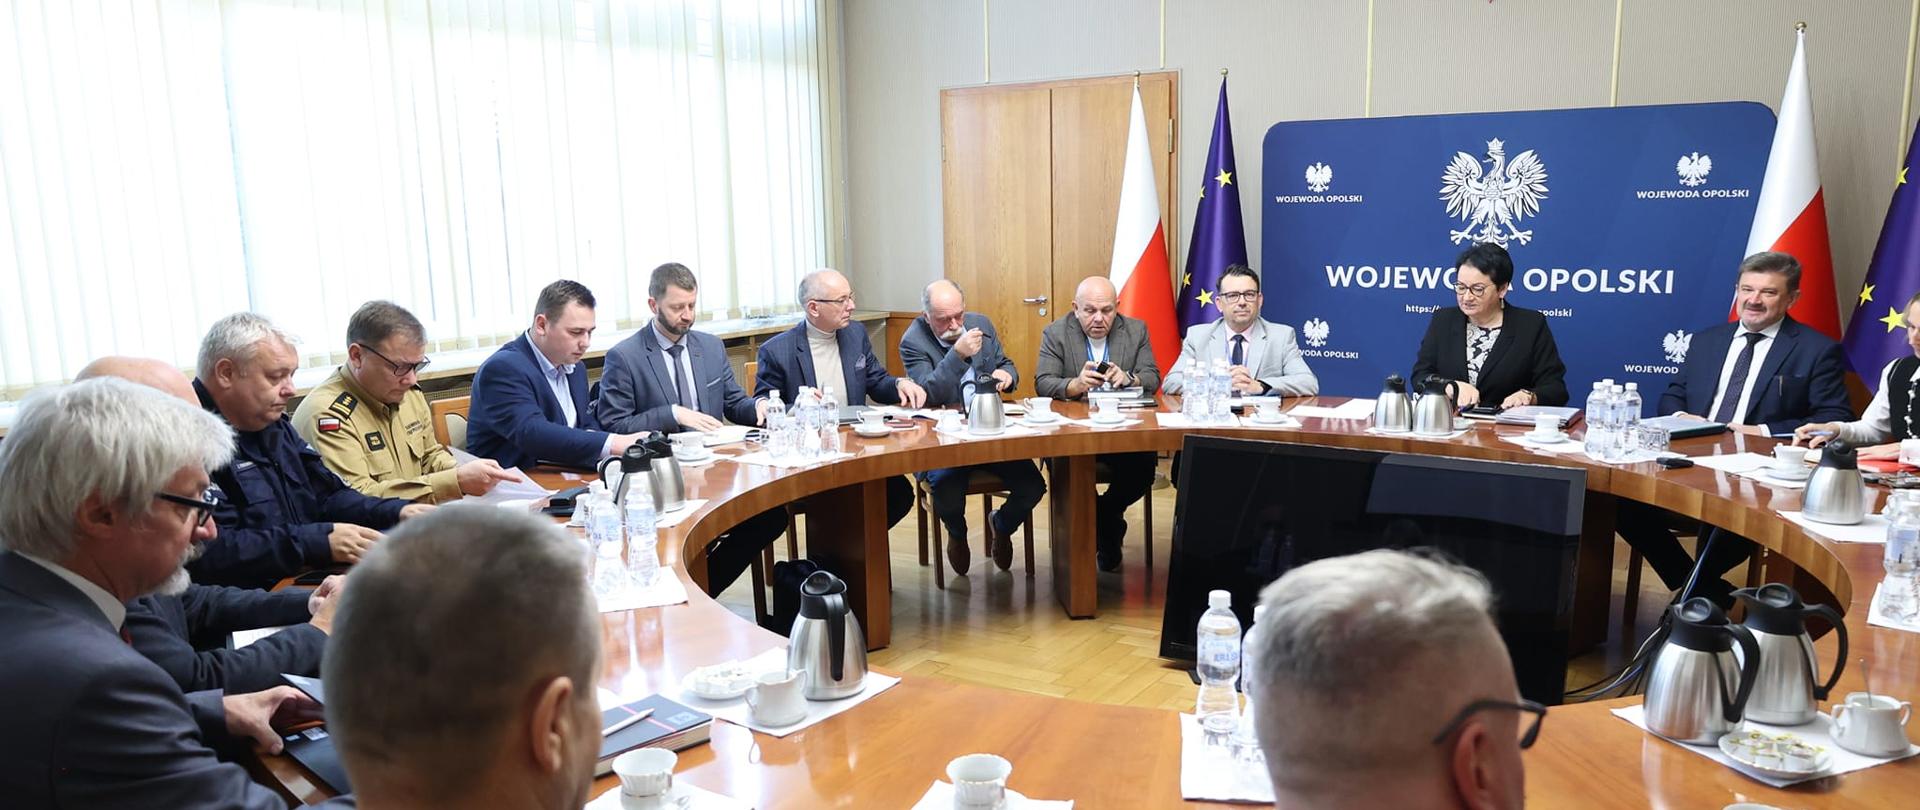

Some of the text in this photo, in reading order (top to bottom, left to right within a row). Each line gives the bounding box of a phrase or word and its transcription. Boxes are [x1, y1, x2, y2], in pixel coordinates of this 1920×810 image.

[1275, 194, 1363, 203] WOJEWODA OPOLSKI
[1636, 189, 1750, 199] WOJEWODA OPOLSKI
[1325, 265, 1674, 294] WOJEWO OPOLSKI
[1323, 351, 1359, 359] OPOLSKI
[1624, 364, 1679, 374] WOJEWOD
